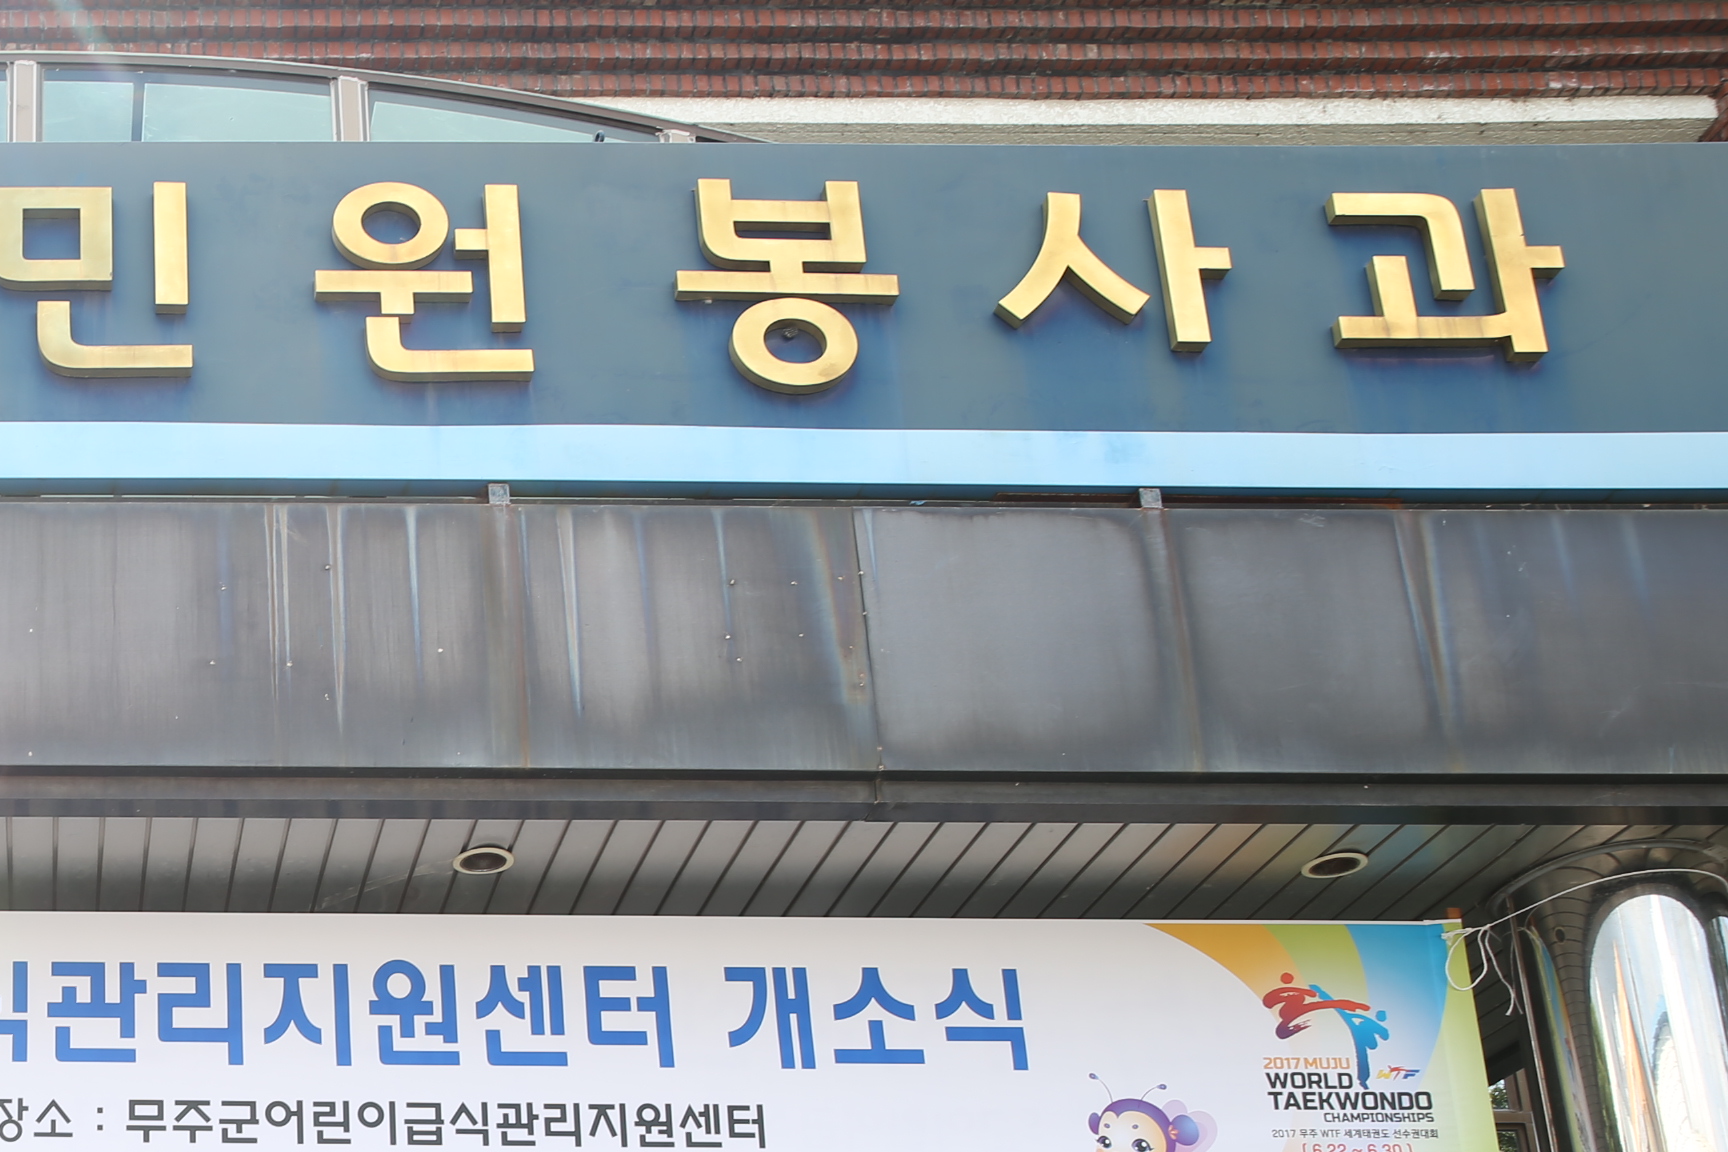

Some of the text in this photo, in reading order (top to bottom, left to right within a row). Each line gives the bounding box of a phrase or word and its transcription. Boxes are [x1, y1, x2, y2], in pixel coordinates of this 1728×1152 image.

[723, 965, 1029, 1072] 개소식
[1263, 1057, 1351, 1070] 2017 MUJU
[1265, 1072, 1354, 1089] WORLD
[1267, 1091, 1433, 1110] TAEKWONDO
[125, 1098, 768, 1149] 무주군어린이급식관리지원센터
[1323, 1112, 1435, 1123] CHAMPIONSHIPS
[1272, 1129, 1296, 1138] 2017
[1321, 1129, 1342, 1138] WTF
[1343, 1128, 1390, 1139] 세계태권도
